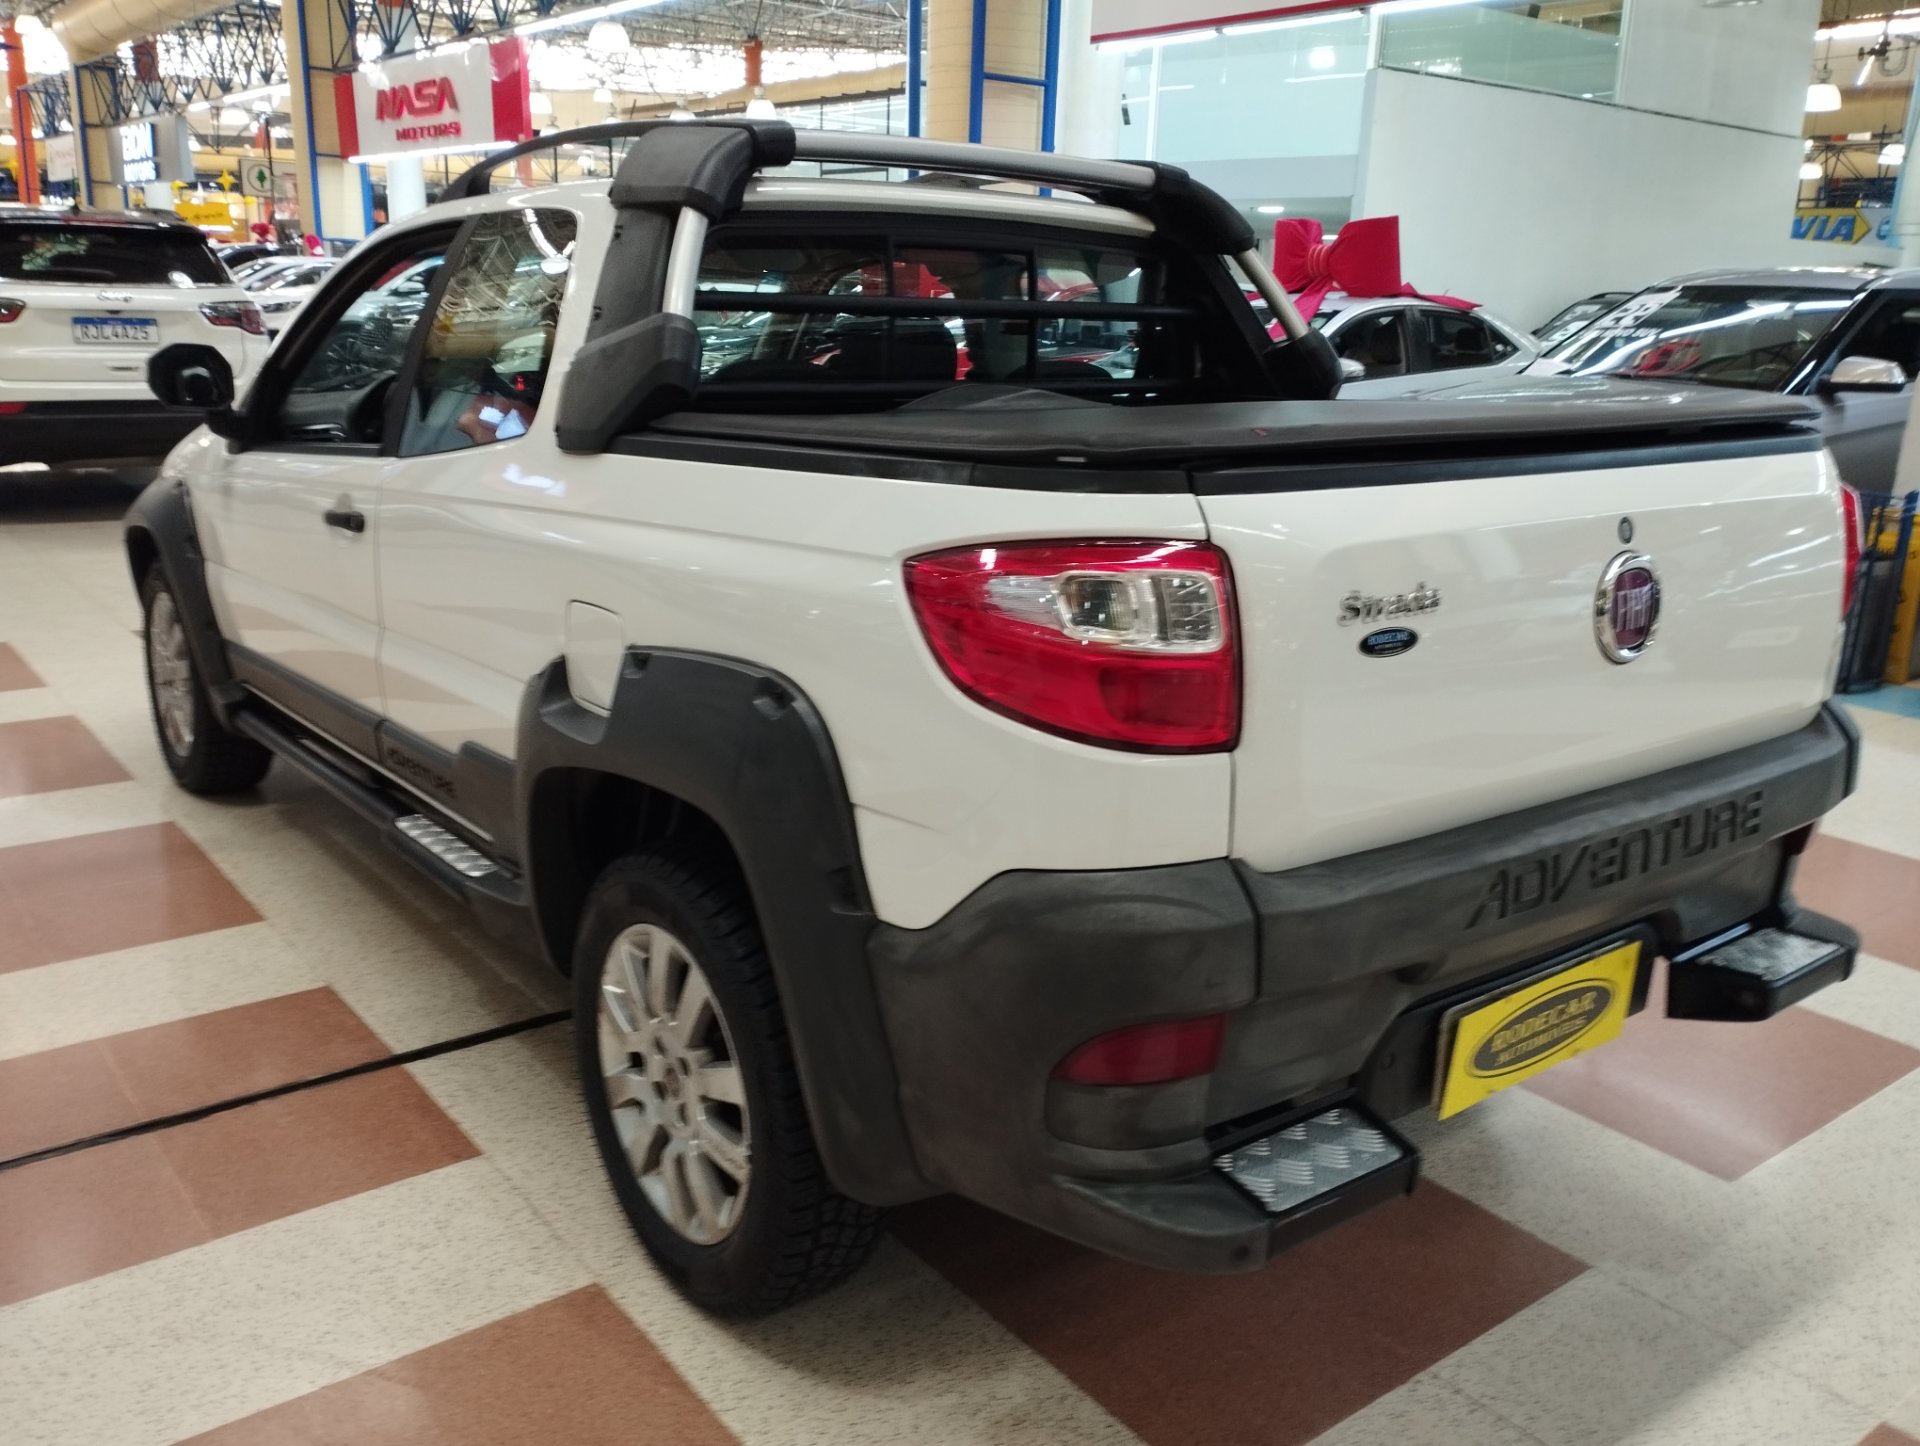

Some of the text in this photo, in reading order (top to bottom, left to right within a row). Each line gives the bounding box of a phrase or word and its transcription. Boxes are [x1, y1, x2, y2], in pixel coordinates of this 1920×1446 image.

[376, 77, 460, 120] NASA
[395, 121, 463, 140] MOTORS
[1791, 214, 1857, 241] VIA
[1338, 581, 1441, 626] Strada
[1615, 583, 1652, 632] FIAT
[1463, 790, 1763, 930] ADVENTURE
